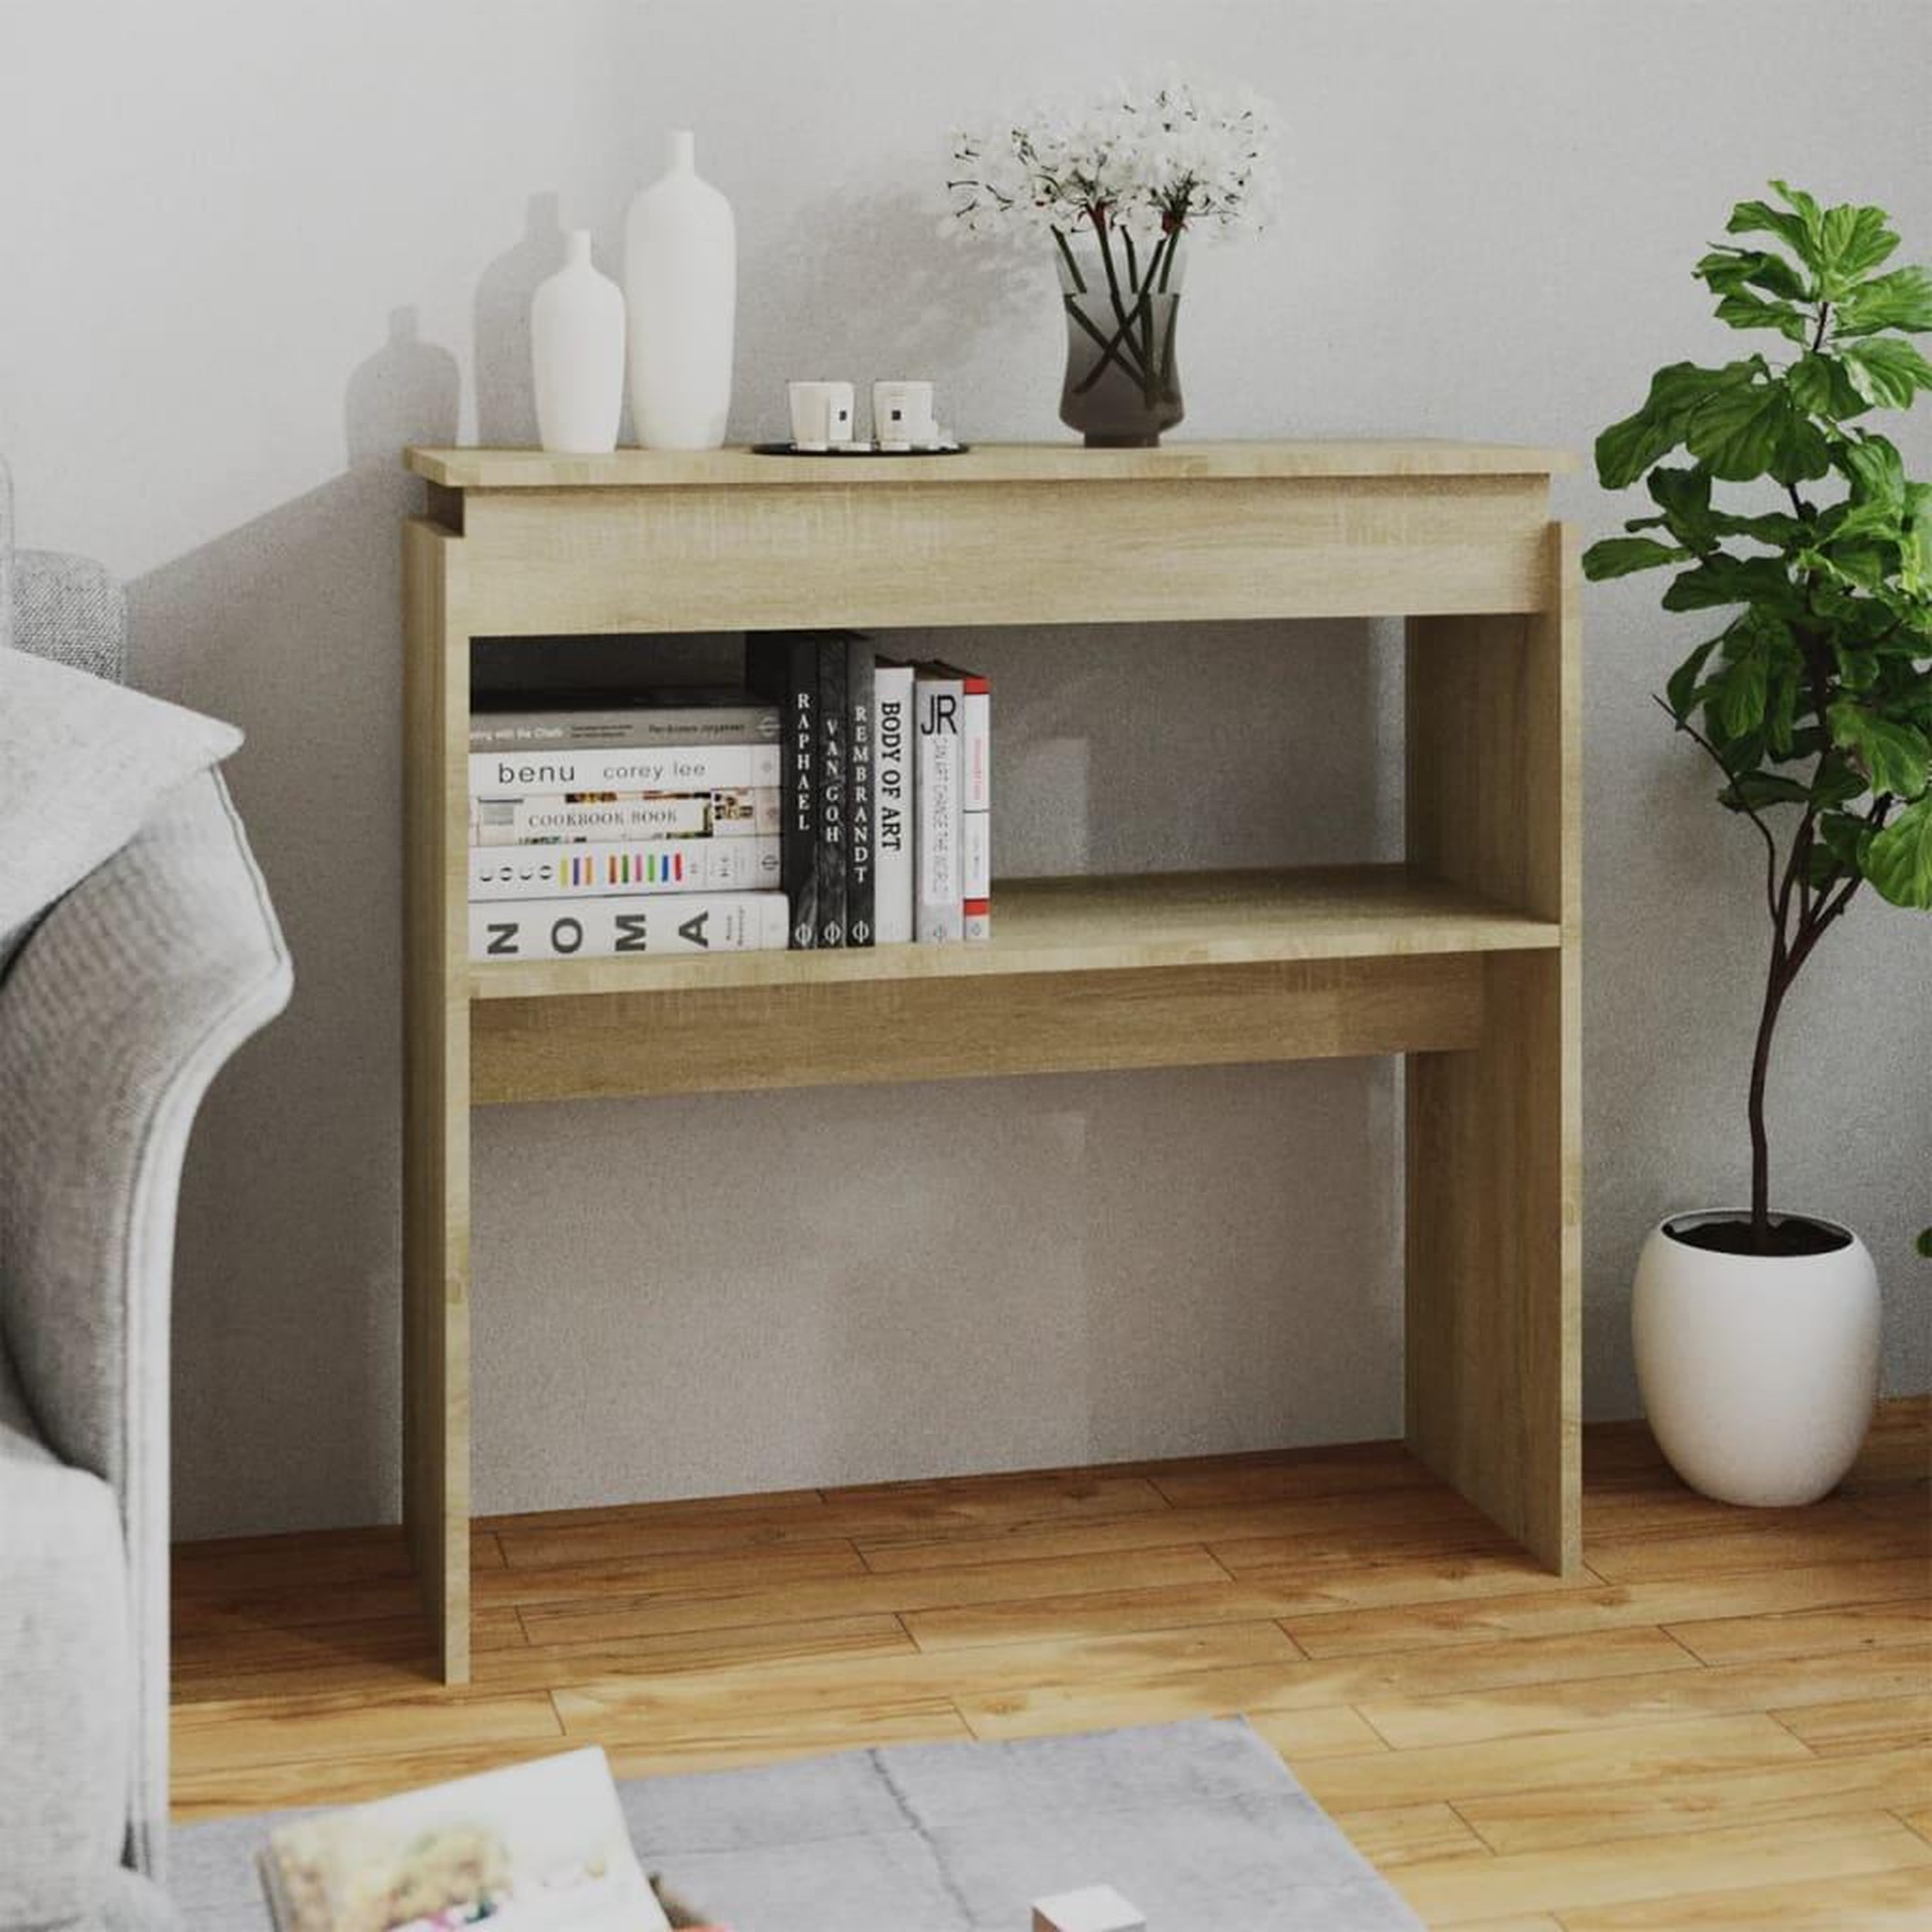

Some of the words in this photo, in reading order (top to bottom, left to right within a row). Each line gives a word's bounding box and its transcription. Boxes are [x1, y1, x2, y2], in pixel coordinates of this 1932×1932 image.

[881, 702, 902, 762] BODY
[921, 694, 957, 735] JR
[498, 762, 576, 784] benu
[603, 763, 664, 781] corey
[674, 761, 707, 777] lee
[797, 692, 811, 831] RAPHAEL
[881, 769, 902, 799] OF
[853, 706, 870, 883] REMBRANDT
[528, 811, 625, 827] COOKBOOK
[631, 809, 677, 825] BOOK
[881, 806, 902, 851] ART
[487, 910, 709, 955] NOMA
